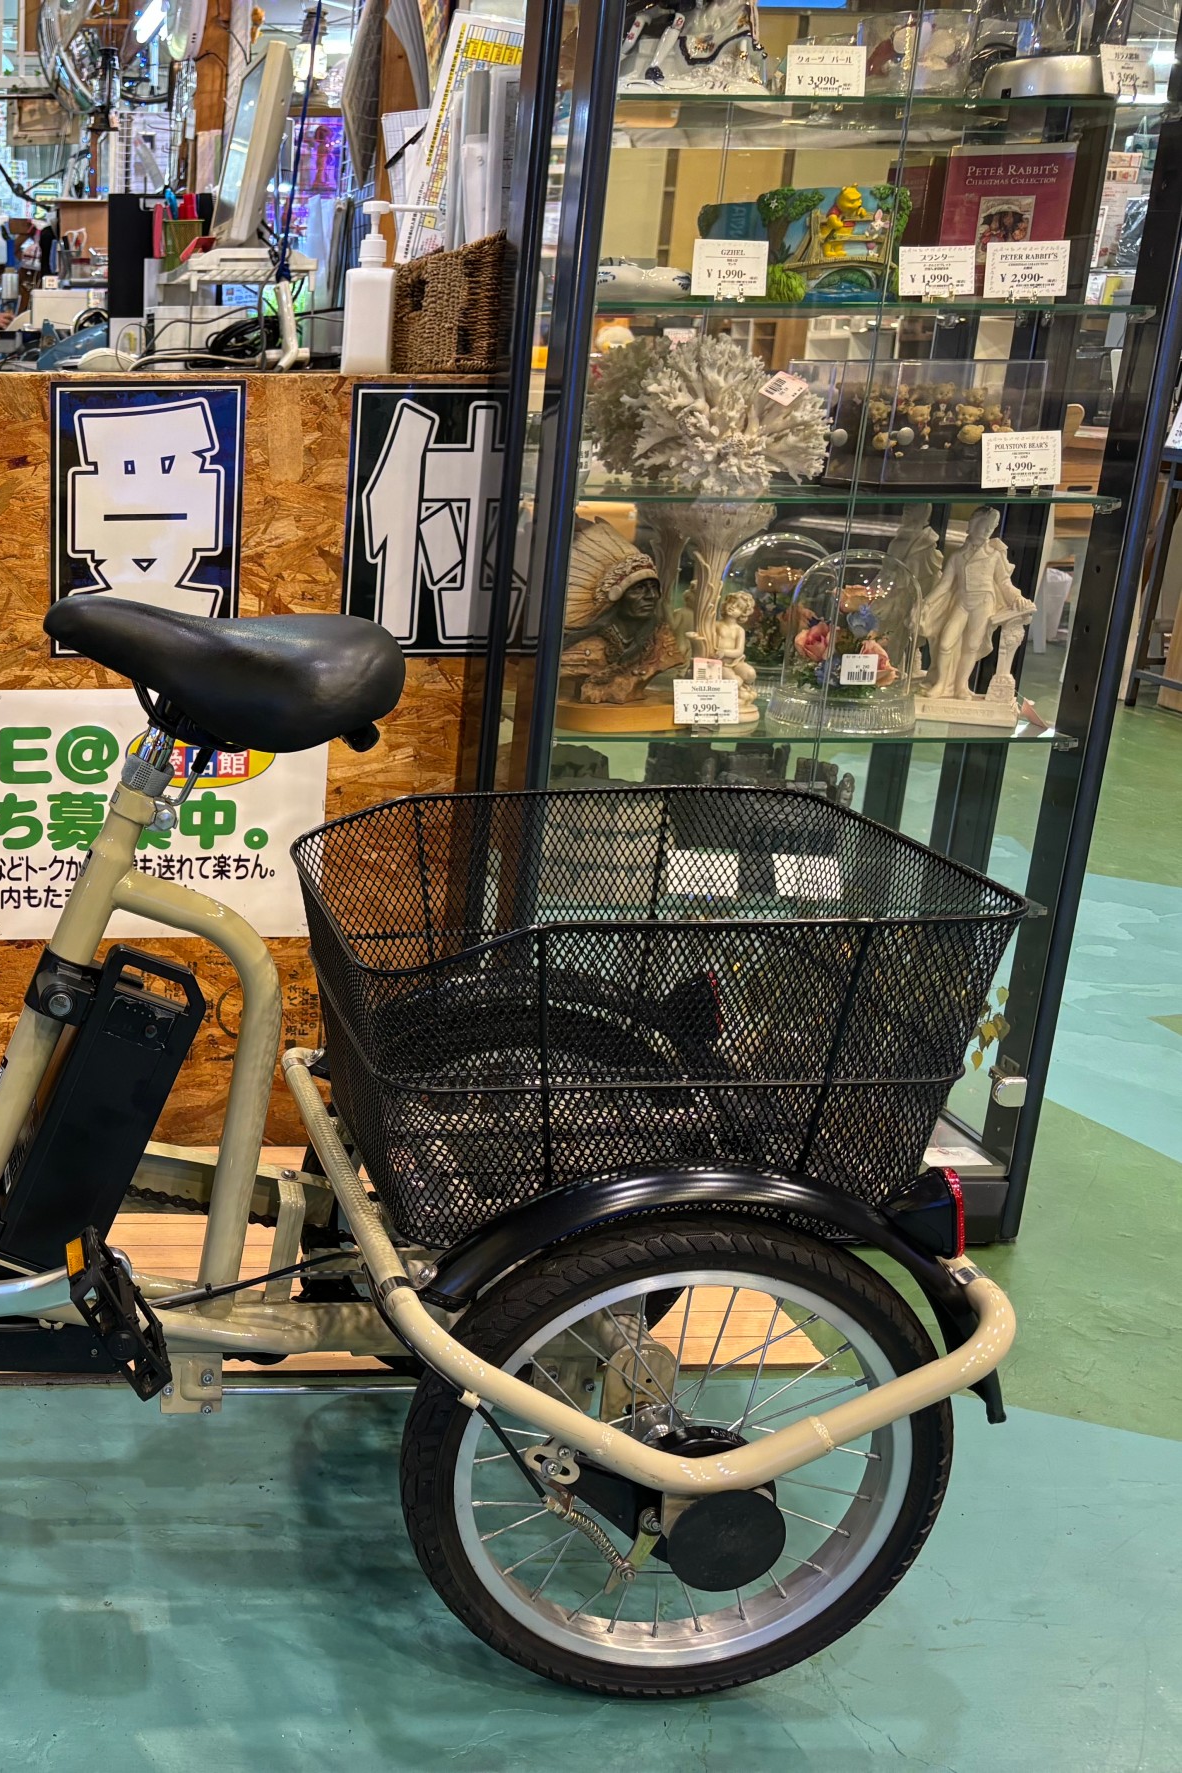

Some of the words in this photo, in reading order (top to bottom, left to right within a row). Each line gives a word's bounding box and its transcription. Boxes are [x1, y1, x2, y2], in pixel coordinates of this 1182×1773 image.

[967, 165, 1004, 177] PETER
[1007, 163, 1059, 175] RABBIT'S
[965, 178, 1009, 186] CHRISTMAS
[1010, 177, 1057, 185] COLLECTION
[1000, 253, 1024, 261] PETER
[1025, 252, 1059, 260] RABBIT'S
[994, 443, 1028, 451] POLYSTONE
[1028, 441, 1049, 449] BEAR'S
